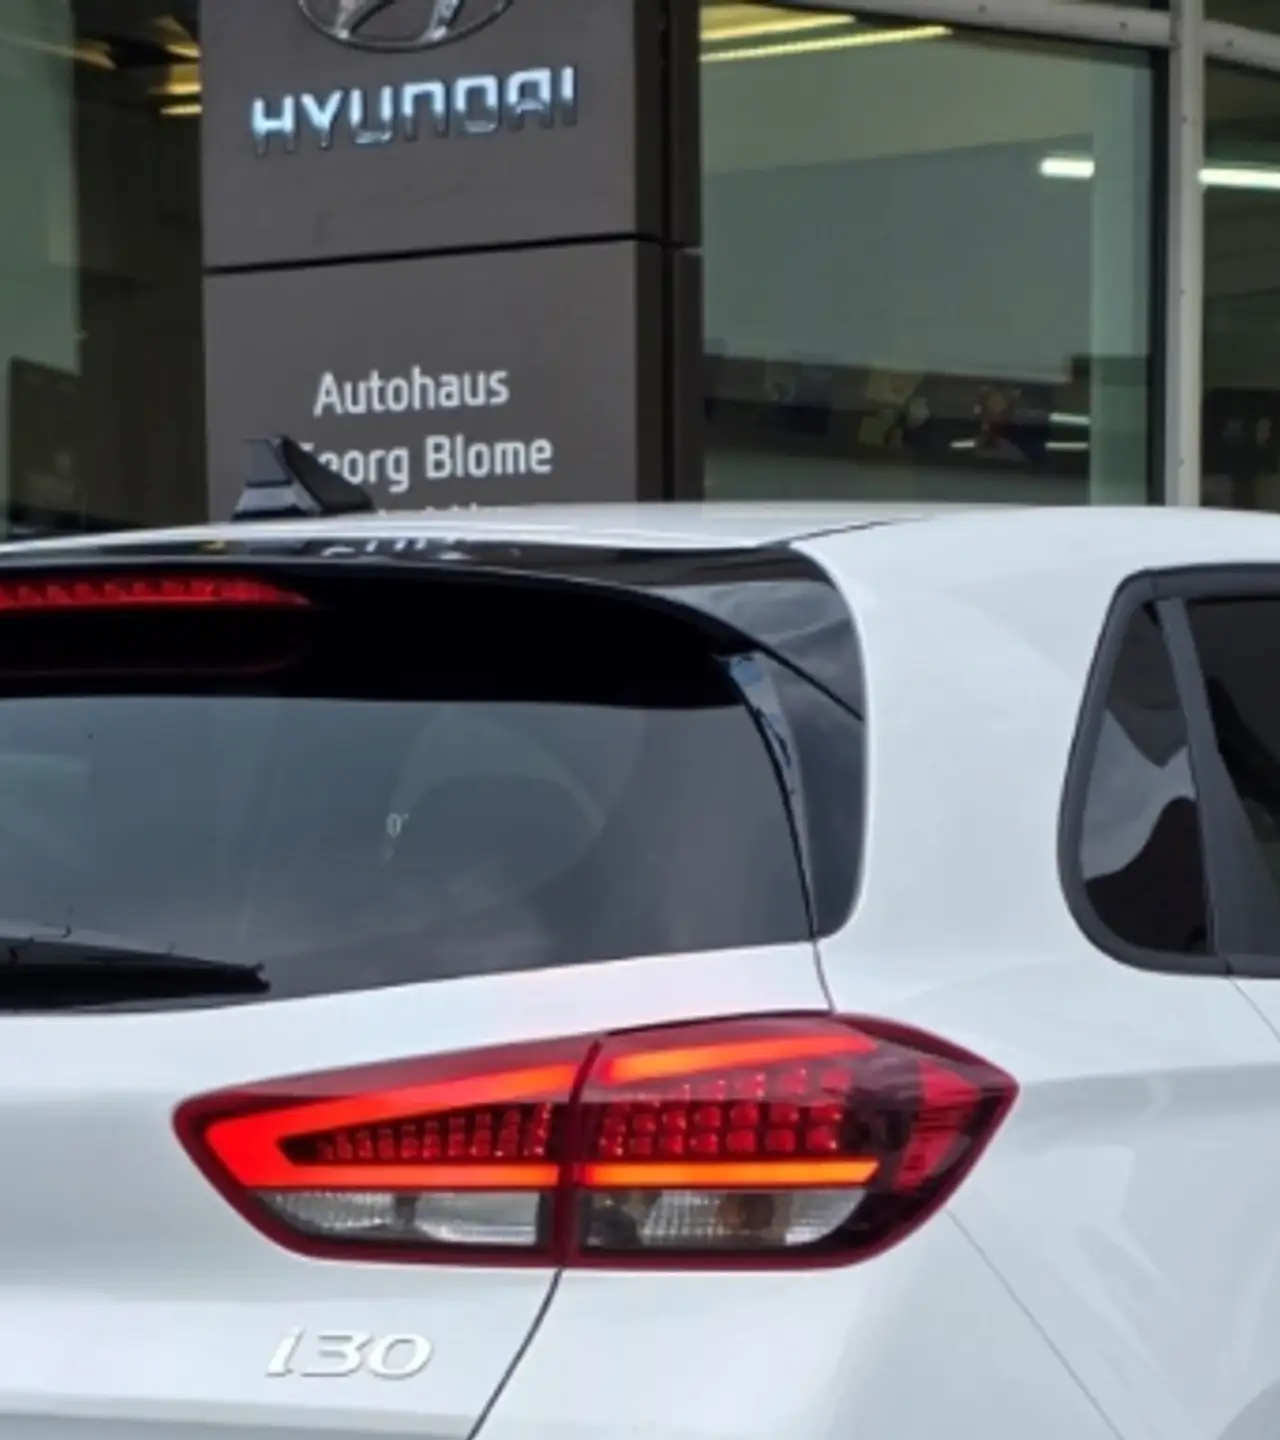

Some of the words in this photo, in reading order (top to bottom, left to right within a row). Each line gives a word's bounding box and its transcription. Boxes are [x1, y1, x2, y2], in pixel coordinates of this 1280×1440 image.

[251, 64, 577, 155] HYUNDAI
[313, 364, 510, 418] Autohaus
[424, 433, 553, 481] Blome
[265, 1326, 435, 1381] i30
